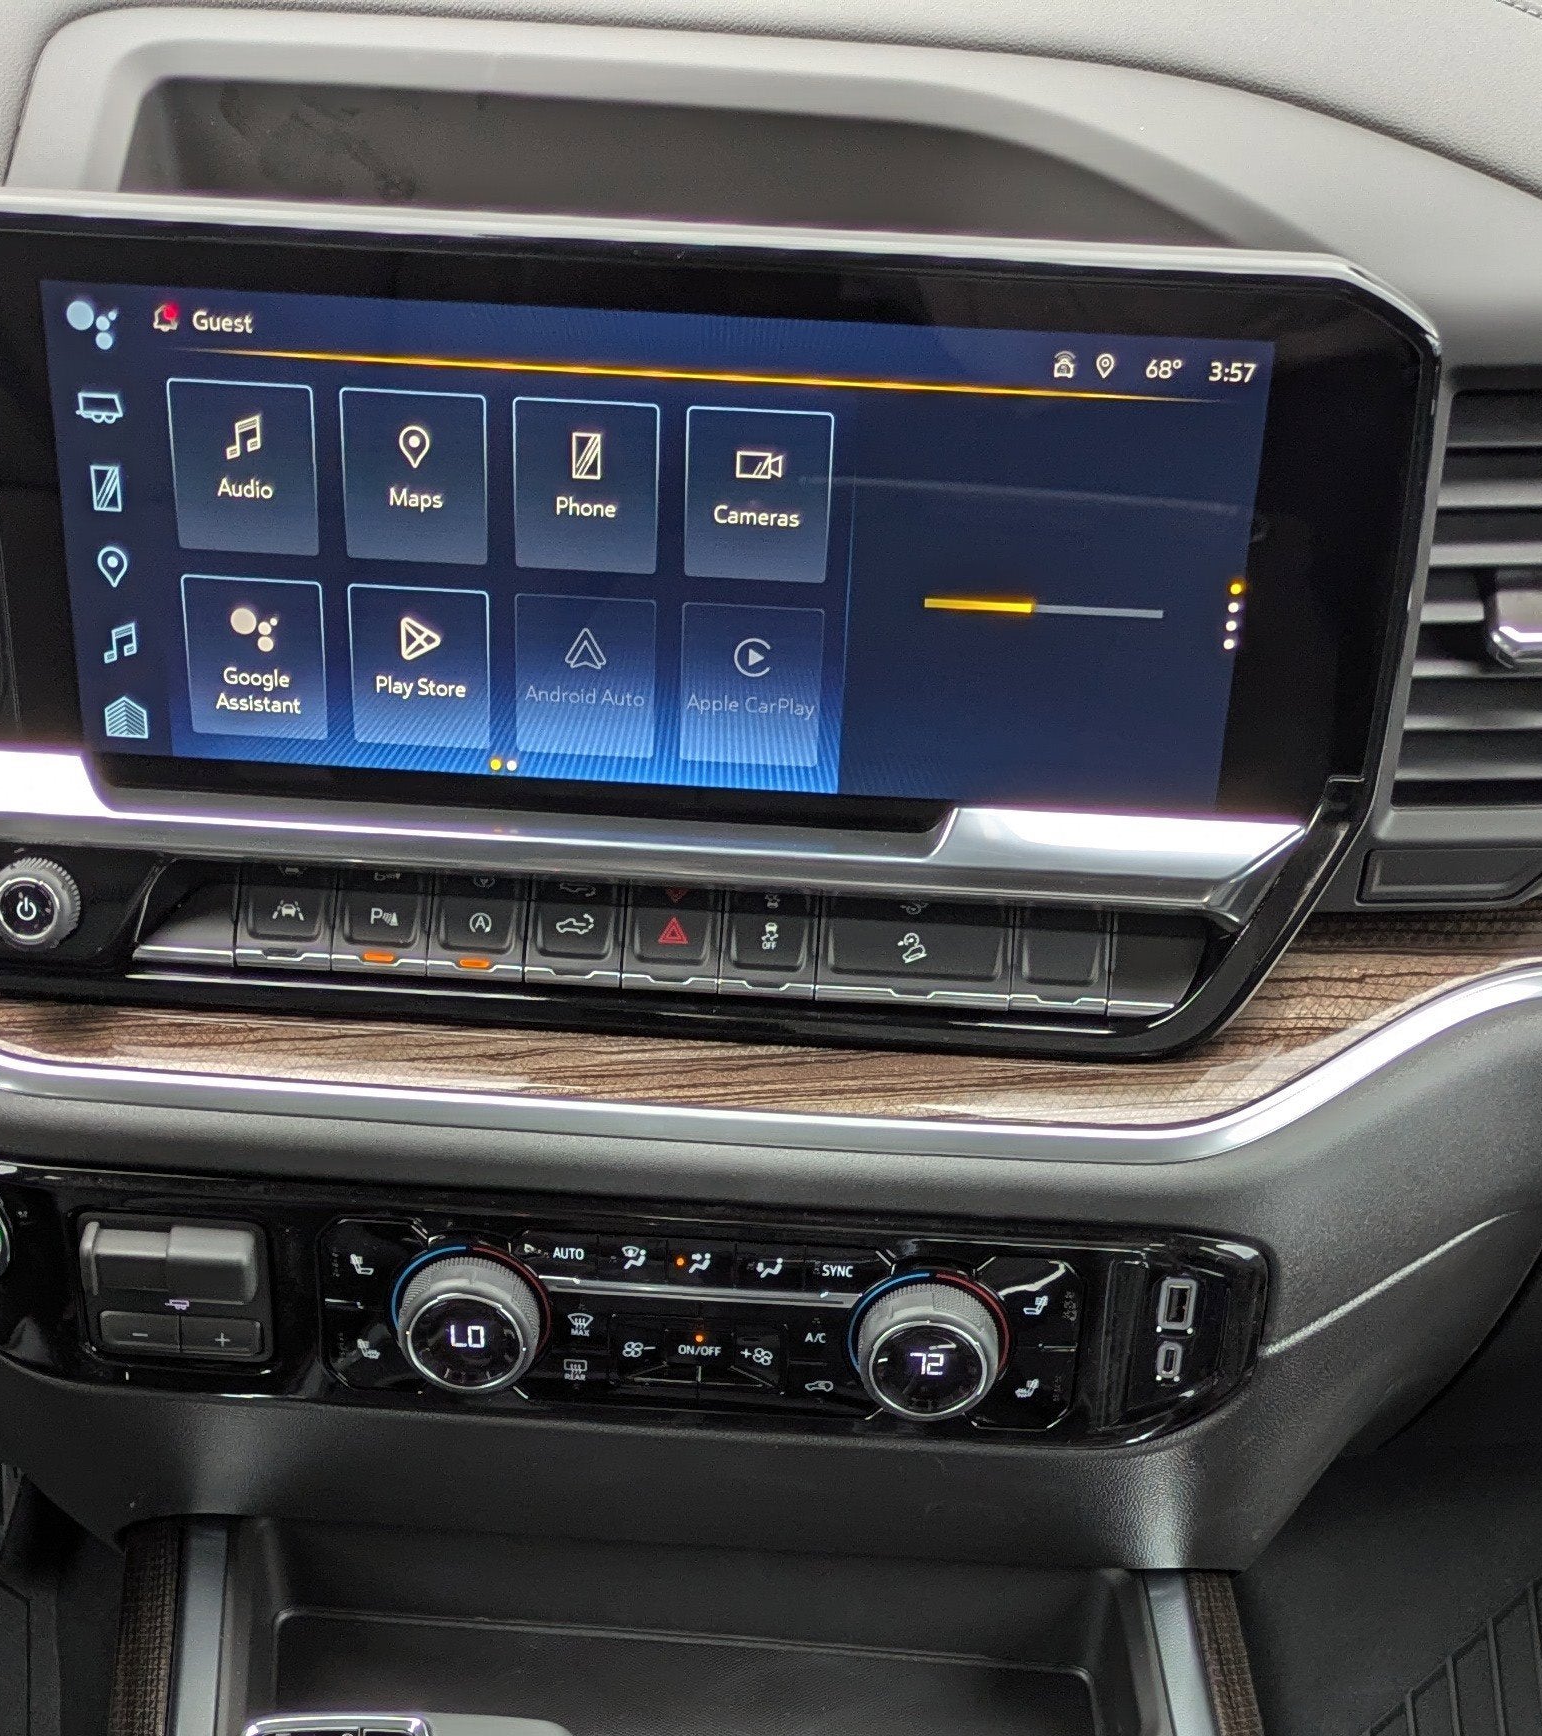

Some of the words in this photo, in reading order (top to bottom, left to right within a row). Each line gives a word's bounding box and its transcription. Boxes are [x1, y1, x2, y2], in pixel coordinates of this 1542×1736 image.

[191, 309, 254, 335] Guest
[1145, 358, 1184, 380] 68°
[1207, 361, 1258, 384] 3:57
[216, 476, 274, 500] Audio
[388, 486, 444, 514] Maps
[555, 496, 617, 519] Phone
[713, 505, 801, 528] Cameras
[222, 665, 291, 693] Google
[375, 674, 414, 700] Play
[417, 678, 467, 699] Store
[215, 691, 302, 715] Assistant
[524, 684, 597, 706] Android
[600, 687, 646, 708] Auto
[685, 694, 739, 716] Apple
[744, 696, 816, 721] CarPlay
[761, 939, 778, 952] OFF
[552, 1247, 586, 1262] AUTO
[821, 1264, 854, 1278] SYNC
[449, 1324, 486, 1349] LO
[570, 1328, 590, 1337] MAX
[804, 1331, 827, 1345] A/C
[677, 1343, 722, 1358] ON/OFF
[909, 1352, 945, 1376] 72
